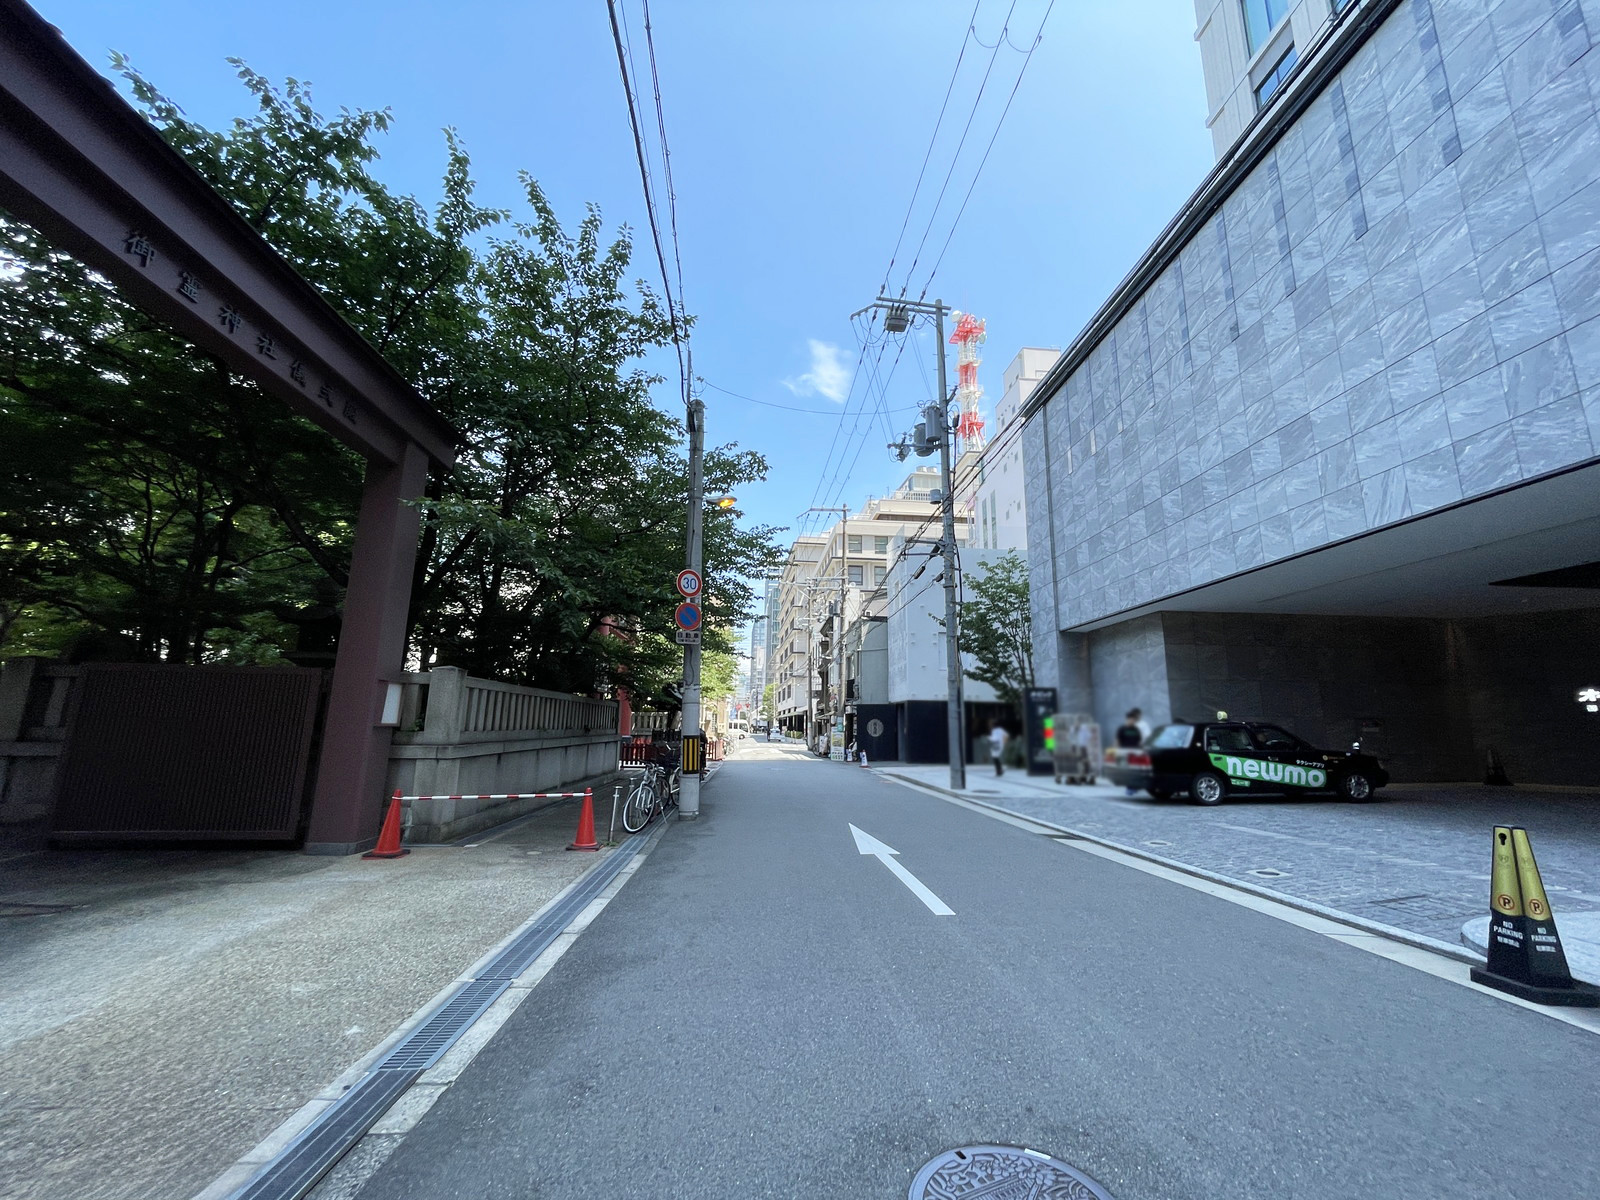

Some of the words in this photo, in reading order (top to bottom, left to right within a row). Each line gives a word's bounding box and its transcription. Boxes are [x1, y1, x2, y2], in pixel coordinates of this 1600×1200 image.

[683, 577, 697, 590] 30
[1296, 759, 1325, 768] タクシーアプリ
[1226, 757, 1326, 788] newmo
[1502, 920, 1513, 929] NO
[1493, 925, 1524, 940] PARKING
[1537, 927, 1547, 935] NO
[1530, 935, 1557, 943] PARKING
